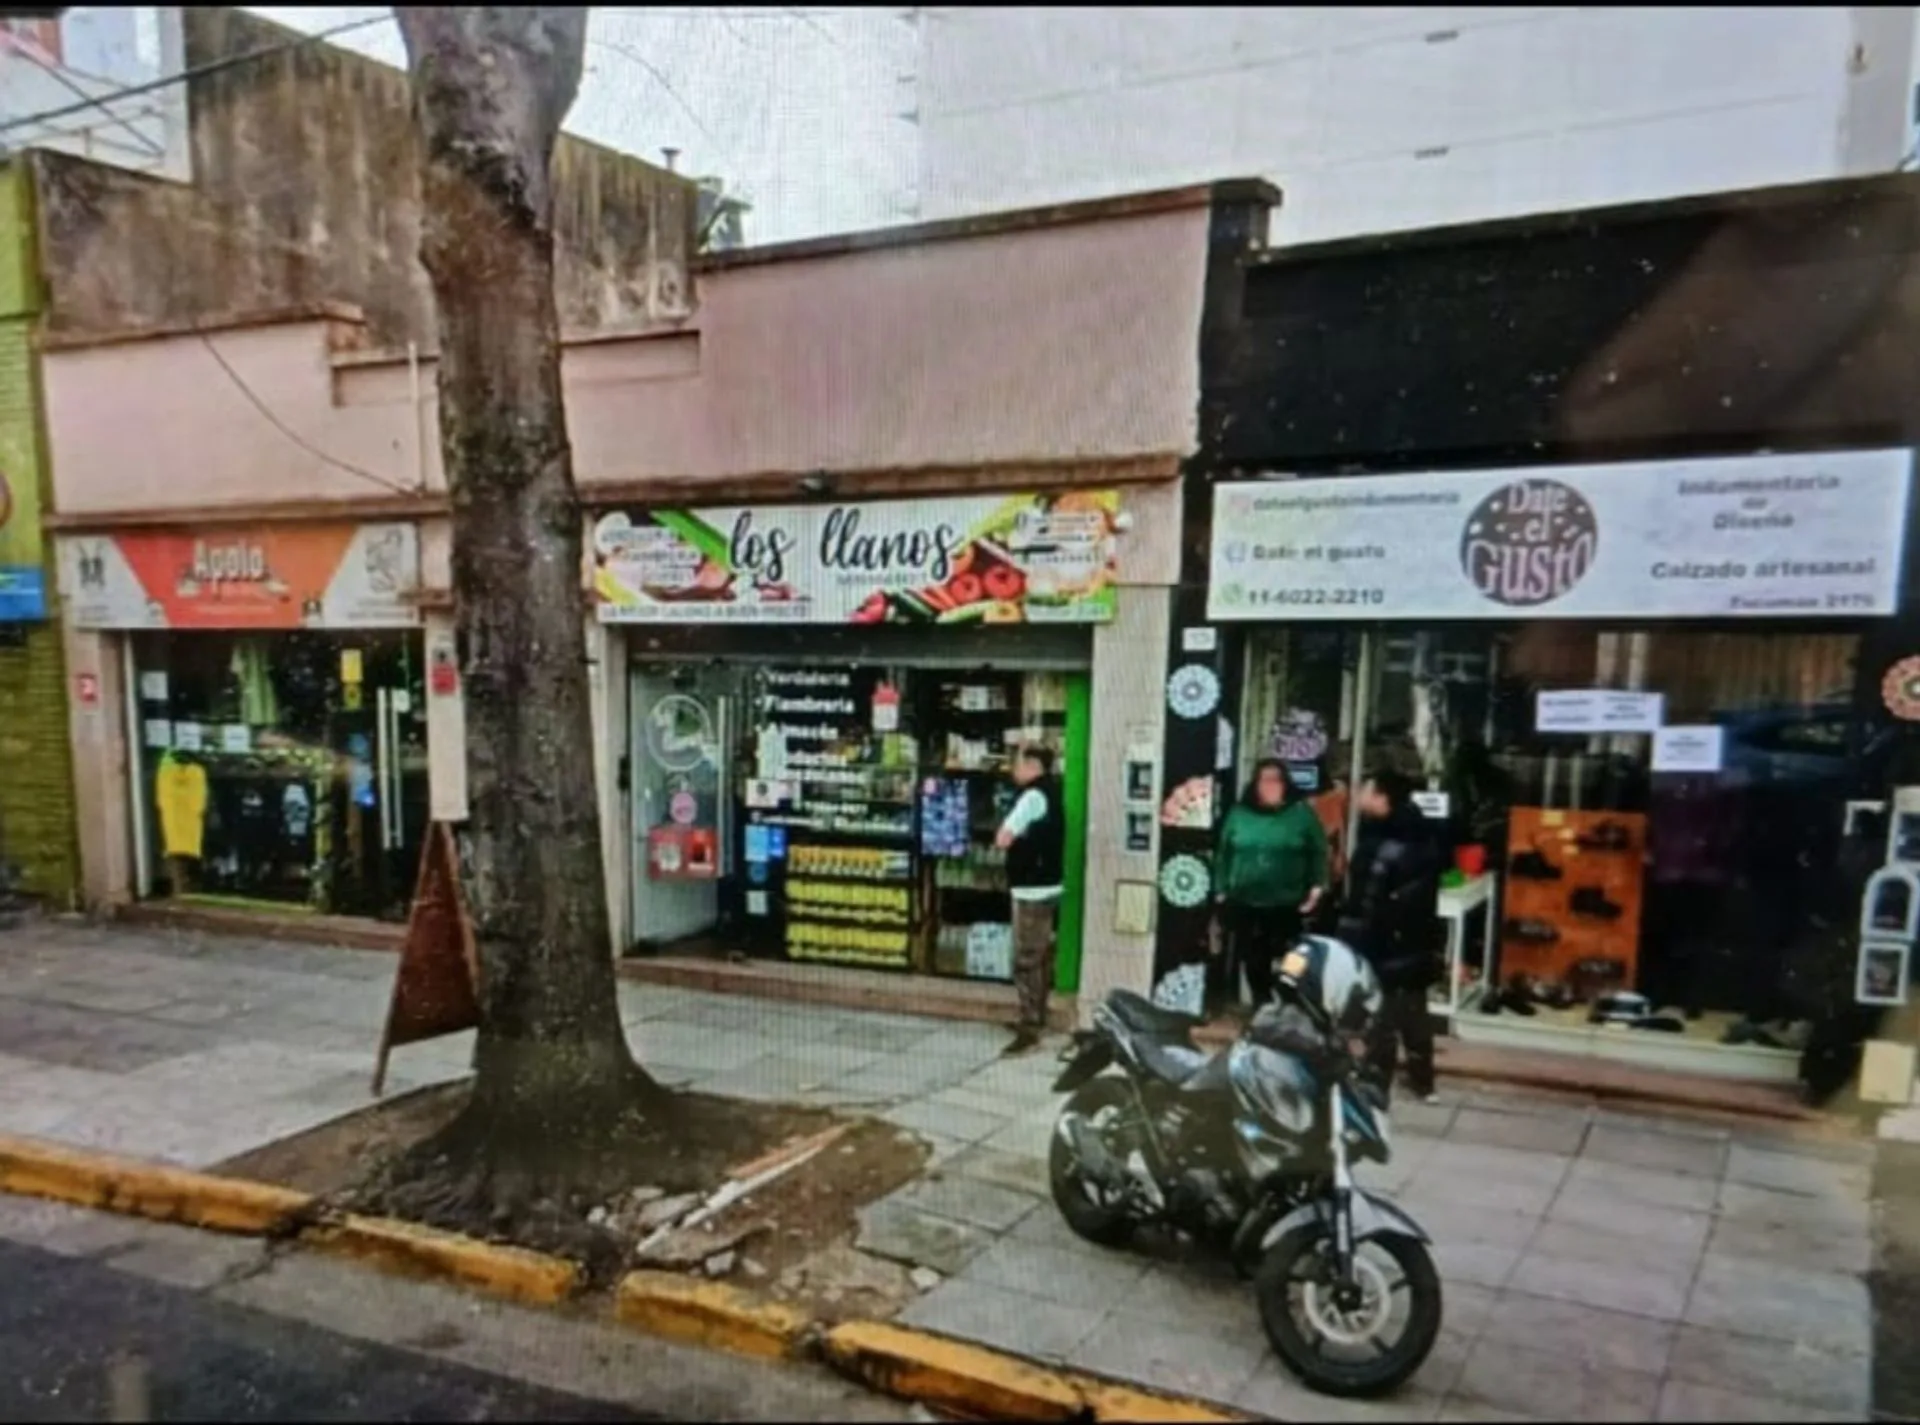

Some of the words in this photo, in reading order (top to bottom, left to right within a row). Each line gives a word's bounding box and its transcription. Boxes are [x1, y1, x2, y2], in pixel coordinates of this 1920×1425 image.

[730, 510, 797, 582] los
[820, 507, 957, 581] llanos
[1651, 560, 1748, 580] Calzado
[1753, 556, 1877, 579] artesanal
